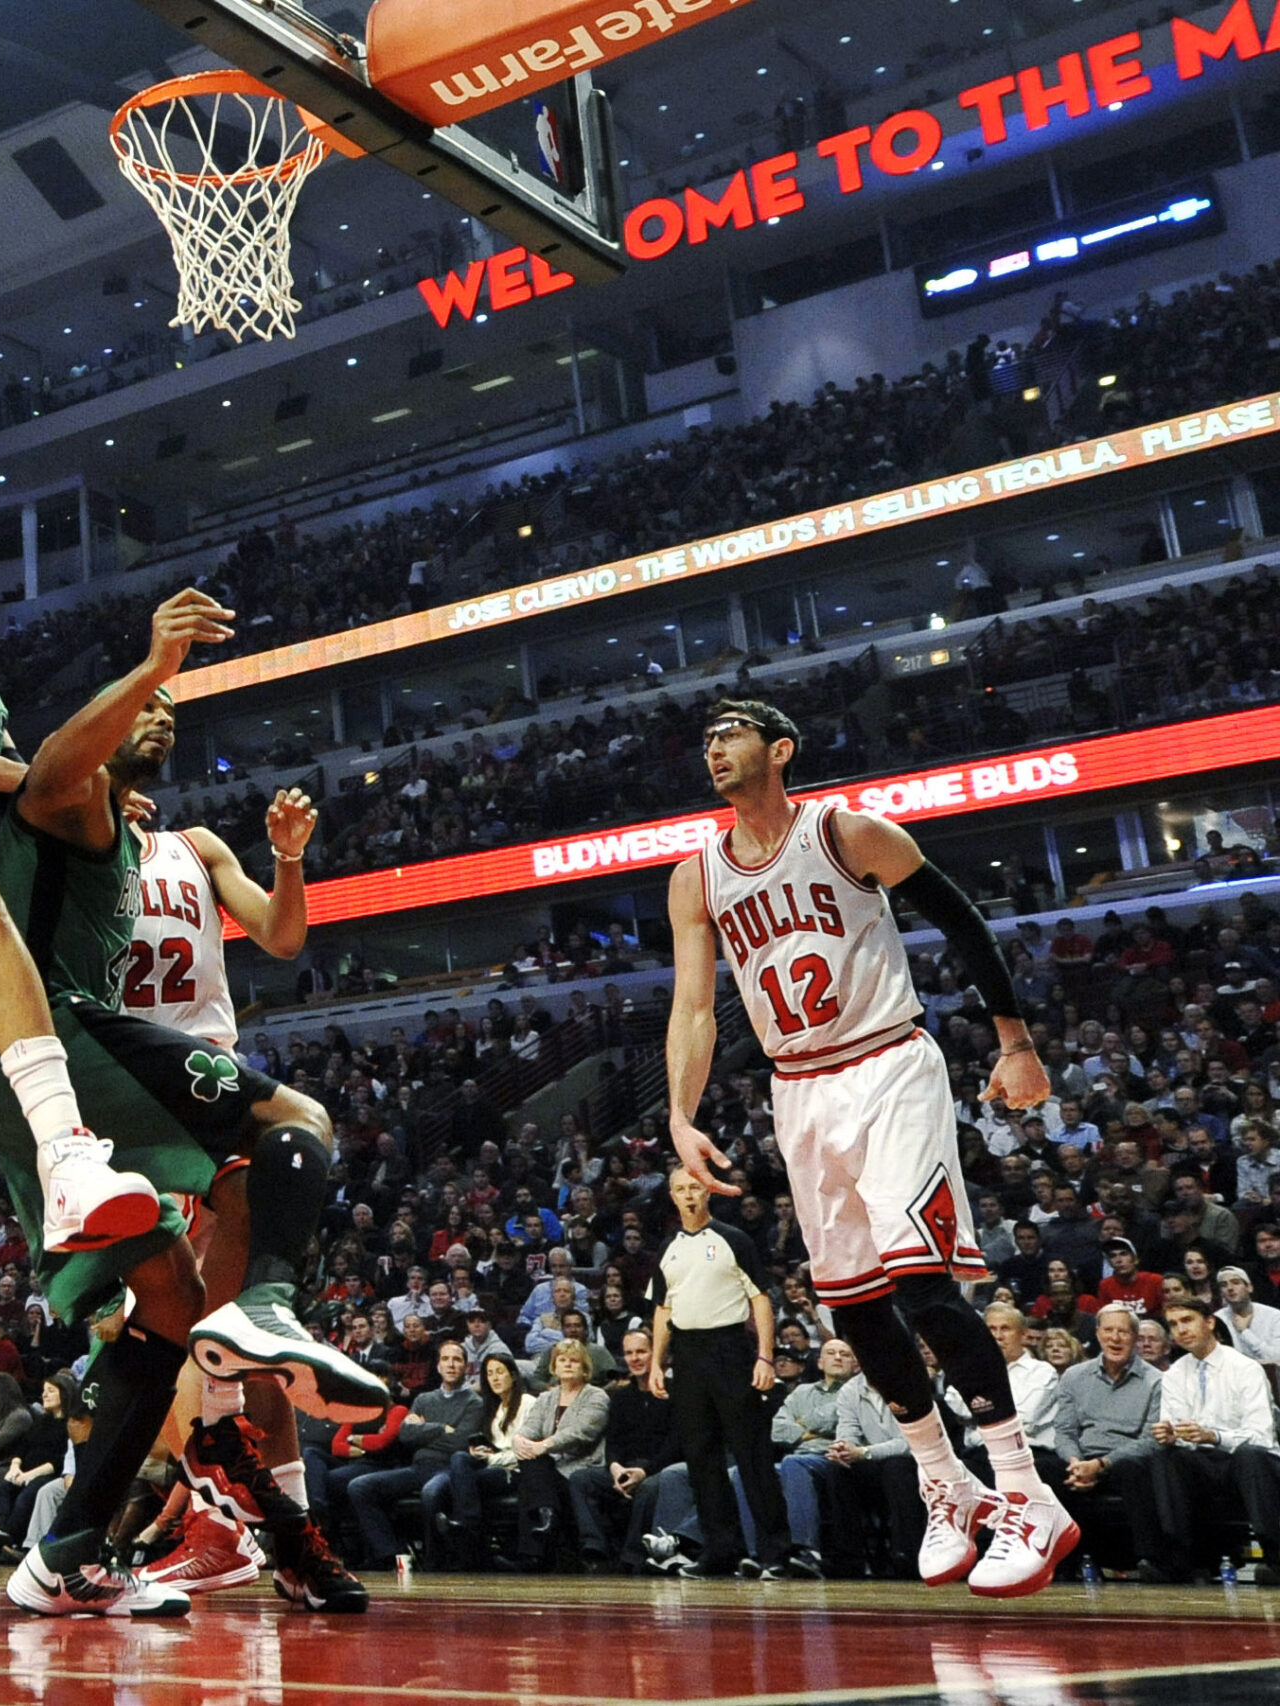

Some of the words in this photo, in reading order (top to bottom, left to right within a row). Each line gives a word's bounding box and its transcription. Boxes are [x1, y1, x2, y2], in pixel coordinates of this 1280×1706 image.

[417, 150, 805, 329] WELOME
[817, 109, 942, 194] TO
[957, 31, 1152, 145] THE
[448, 595, 511, 630] JOSE
[516, 569, 617, 613] CUERVO
[636, 553, 687, 583] THE
[691, 517, 817, 569] WORLD'S
[821, 509, 856, 536] #1
[862, 477, 980, 526] SELLING
[985, 441, 1126, 494] TEQUILA.
[1141, 400, 1275, 457] PLEASE
[532, 818, 719, 878] BUDWEISER
[859, 772, 966, 817] SOME
[971, 752, 1079, 799] BUDS
[140, 878, 202, 931] LLS
[718, 883, 845, 969] BULLS
[123, 937, 196, 1008] 22
[759, 953, 839, 1036] 12
